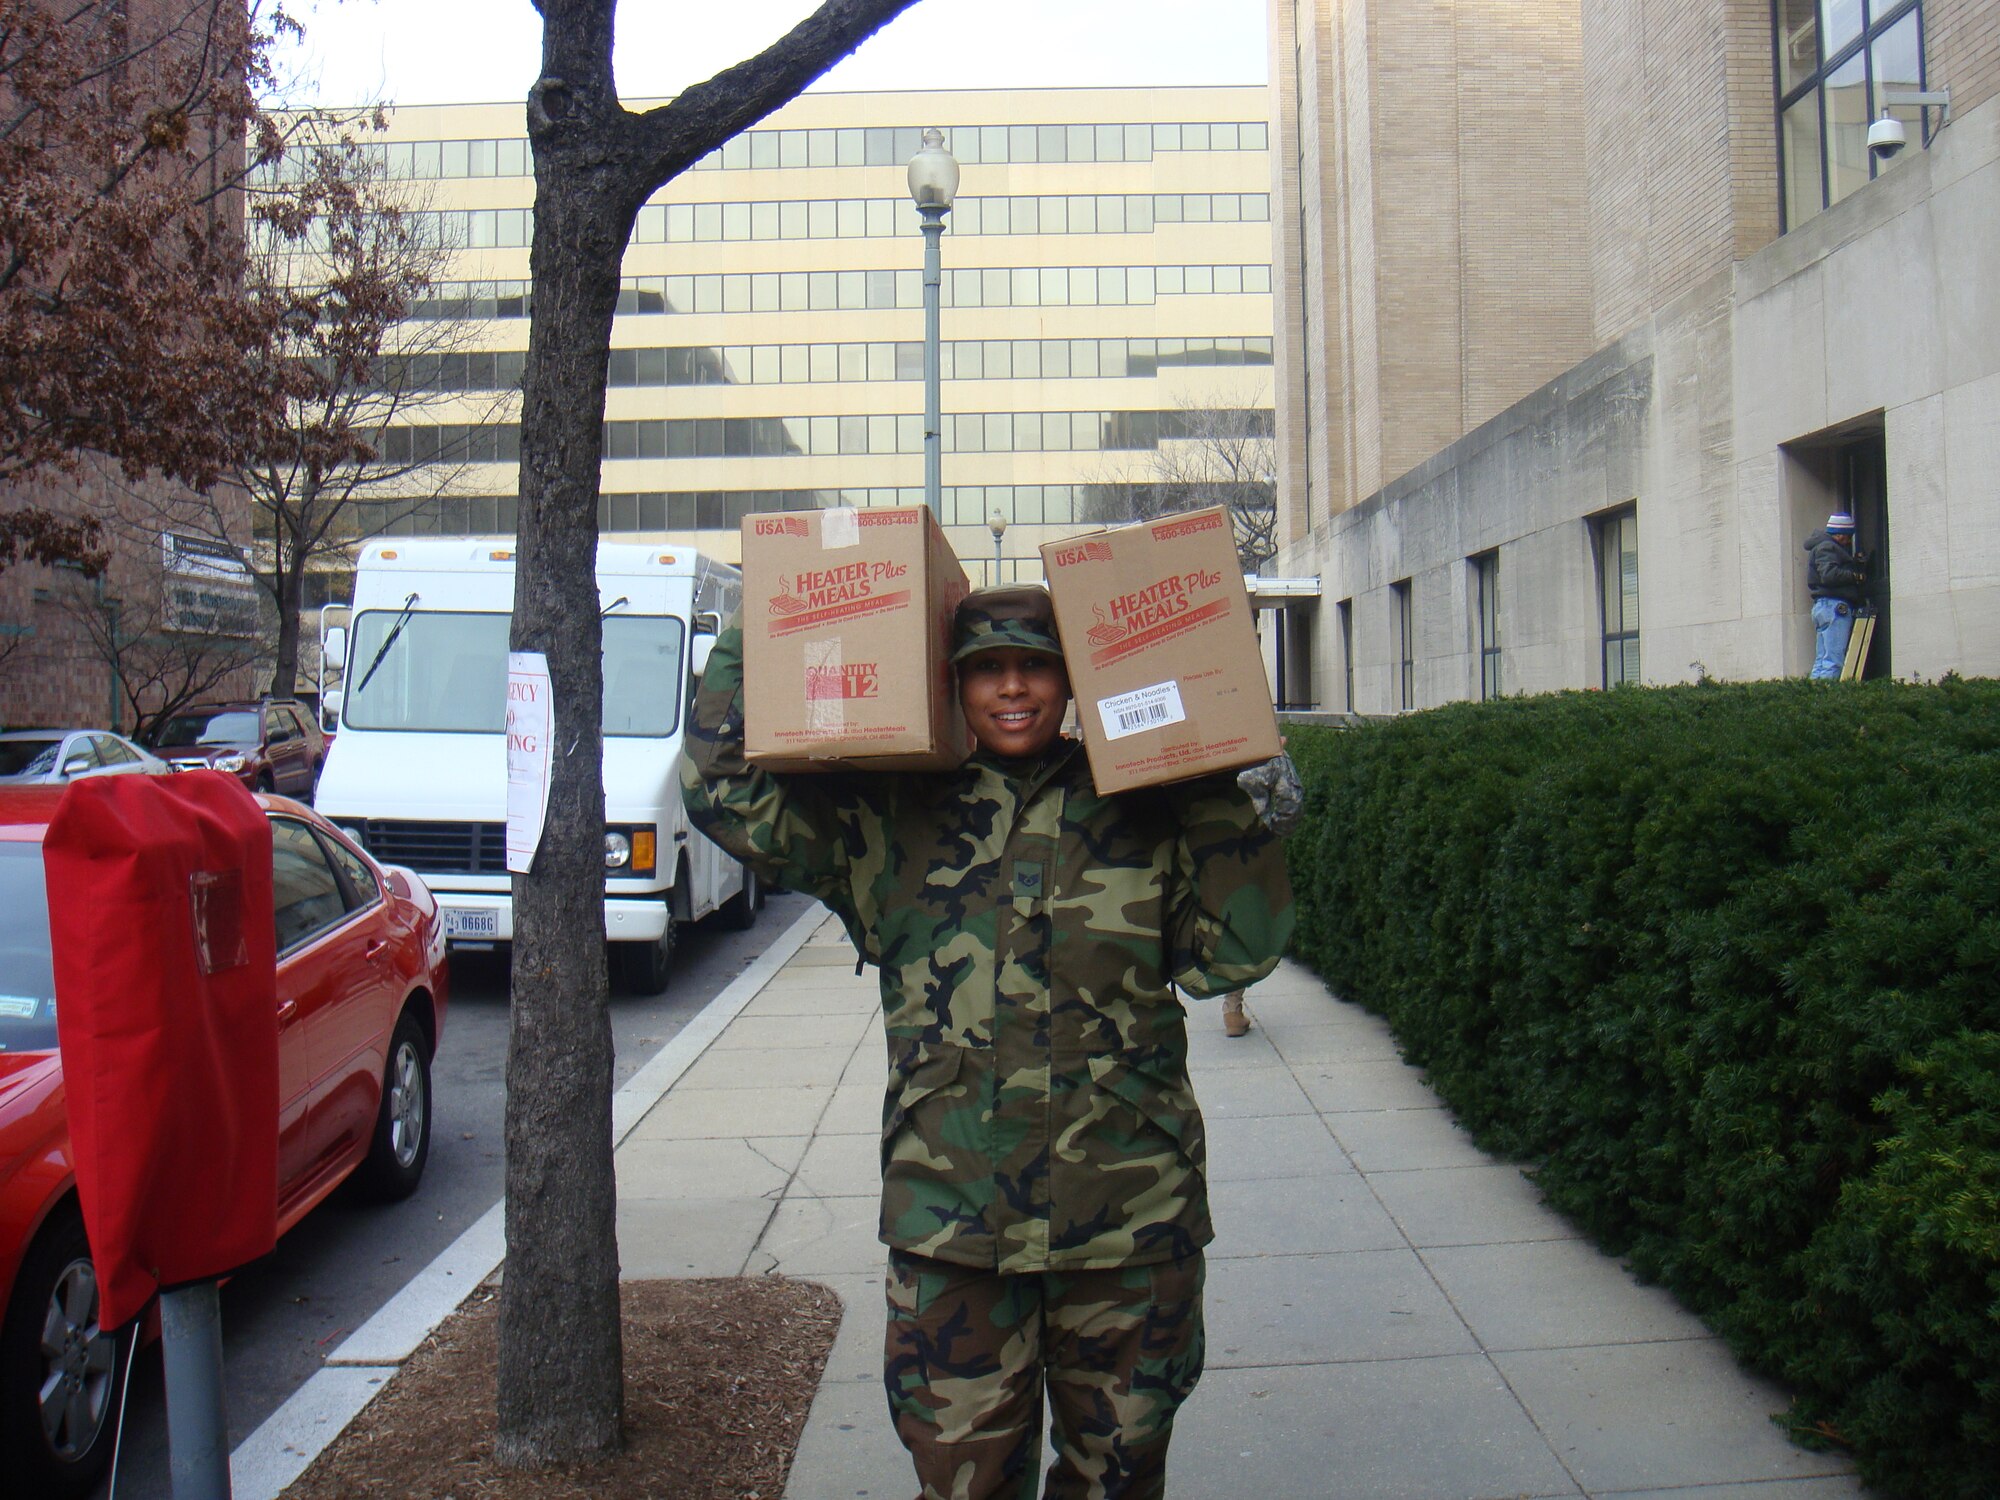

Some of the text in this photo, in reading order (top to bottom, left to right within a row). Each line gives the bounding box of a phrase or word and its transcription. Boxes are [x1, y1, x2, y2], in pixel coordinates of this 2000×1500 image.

[755, 523, 785, 536] USA
[1154, 520, 1223, 542] 1-800-503-4483
[1056, 550, 1088, 567] USA
[796, 560, 907, 594] HEATER Plus
[807, 579, 871, 610] MEALS
[1109, 569, 1222, 621] HEATER Plus
[1126, 593, 1189, 635] MEALS
[806, 663, 878, 678] QUANTITY
[847, 675, 878, 697] 12
[1104, 694, 1133, 709] Chicken
[1134, 693, 1140, 701] &
[1141, 686, 1171, 699] Noodles
[863, 725, 906, 734] HeaterMeals
[508, 733, 537, 754] ING
[1205, 737, 1248, 751] HeaterMeals
[462, 916, 493, 931] 0668G
